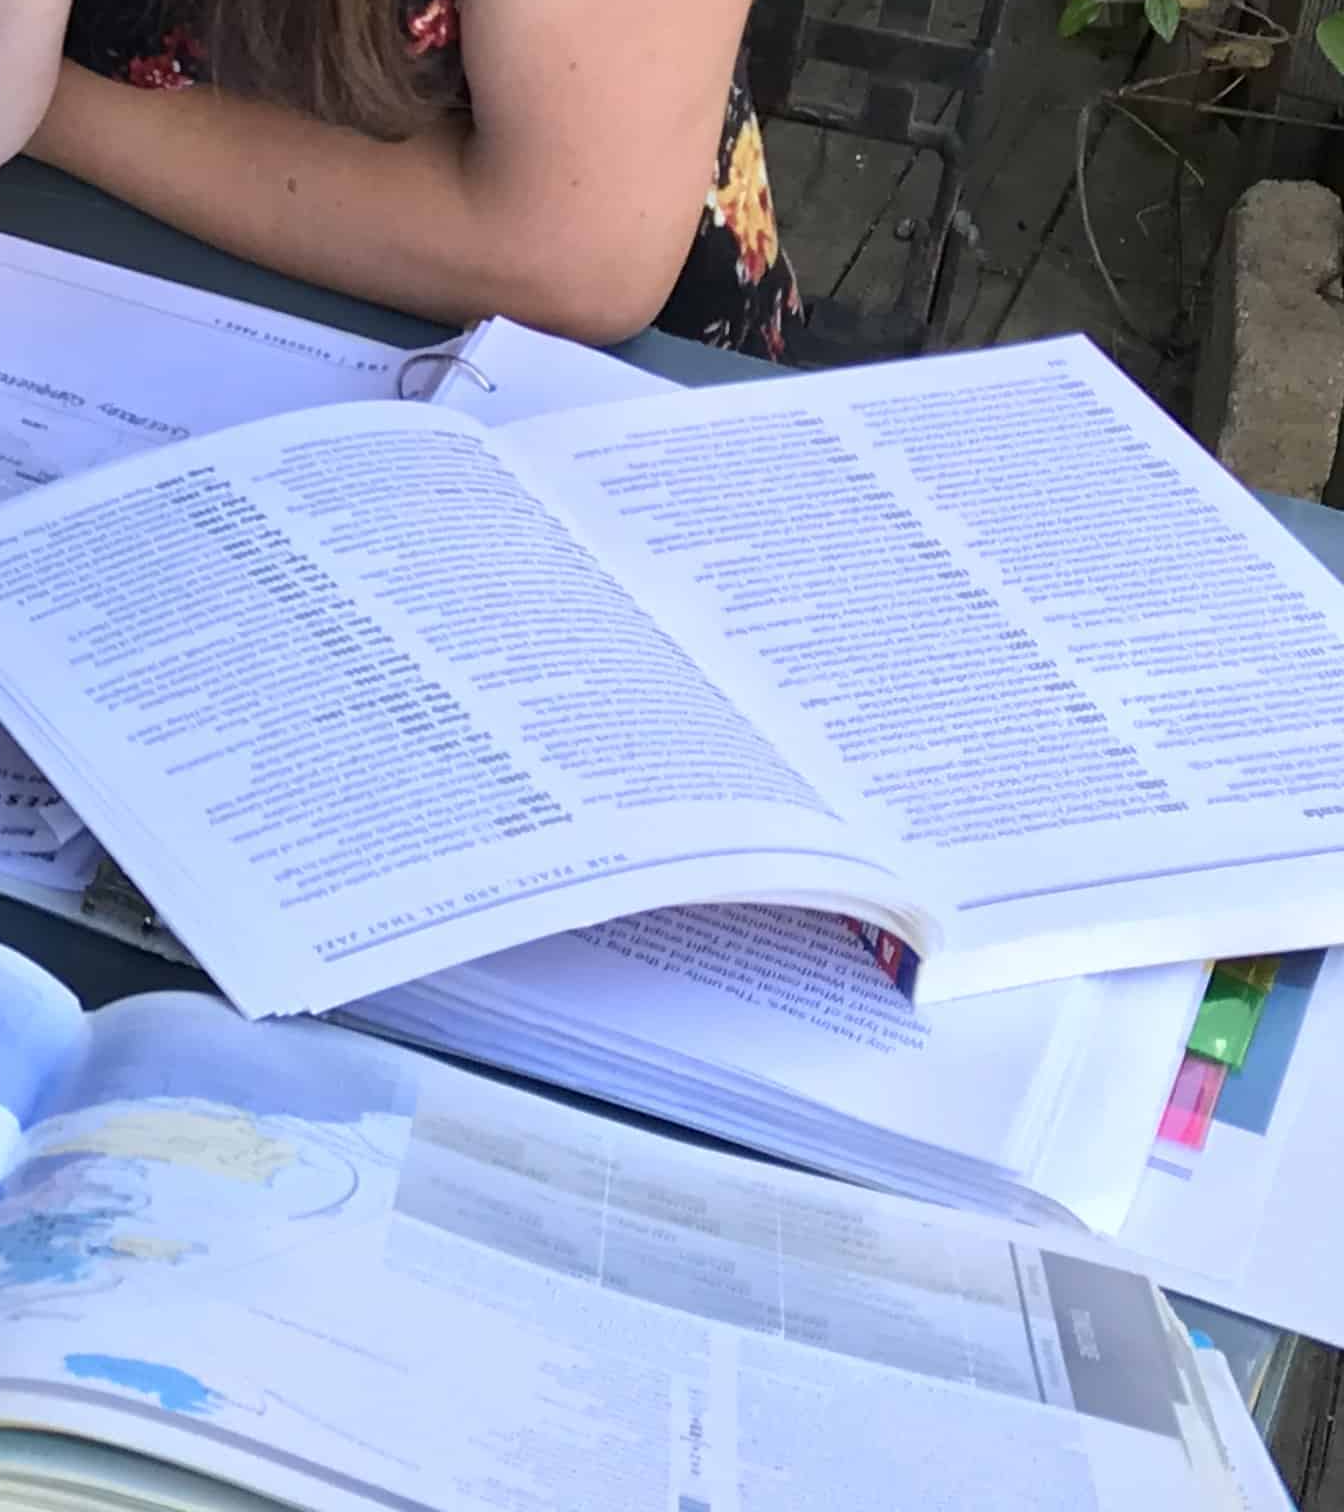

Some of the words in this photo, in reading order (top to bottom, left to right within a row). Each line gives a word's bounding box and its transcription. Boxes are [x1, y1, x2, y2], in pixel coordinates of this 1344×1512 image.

[463, 885, 500, 903] AND
[425, 899, 455, 916] ALL
[635, 951, 659, 966] the
[663, 963, 680, 975] of
[687, 969, 721, 989] unity
[882, 1027, 923, 1050] What
